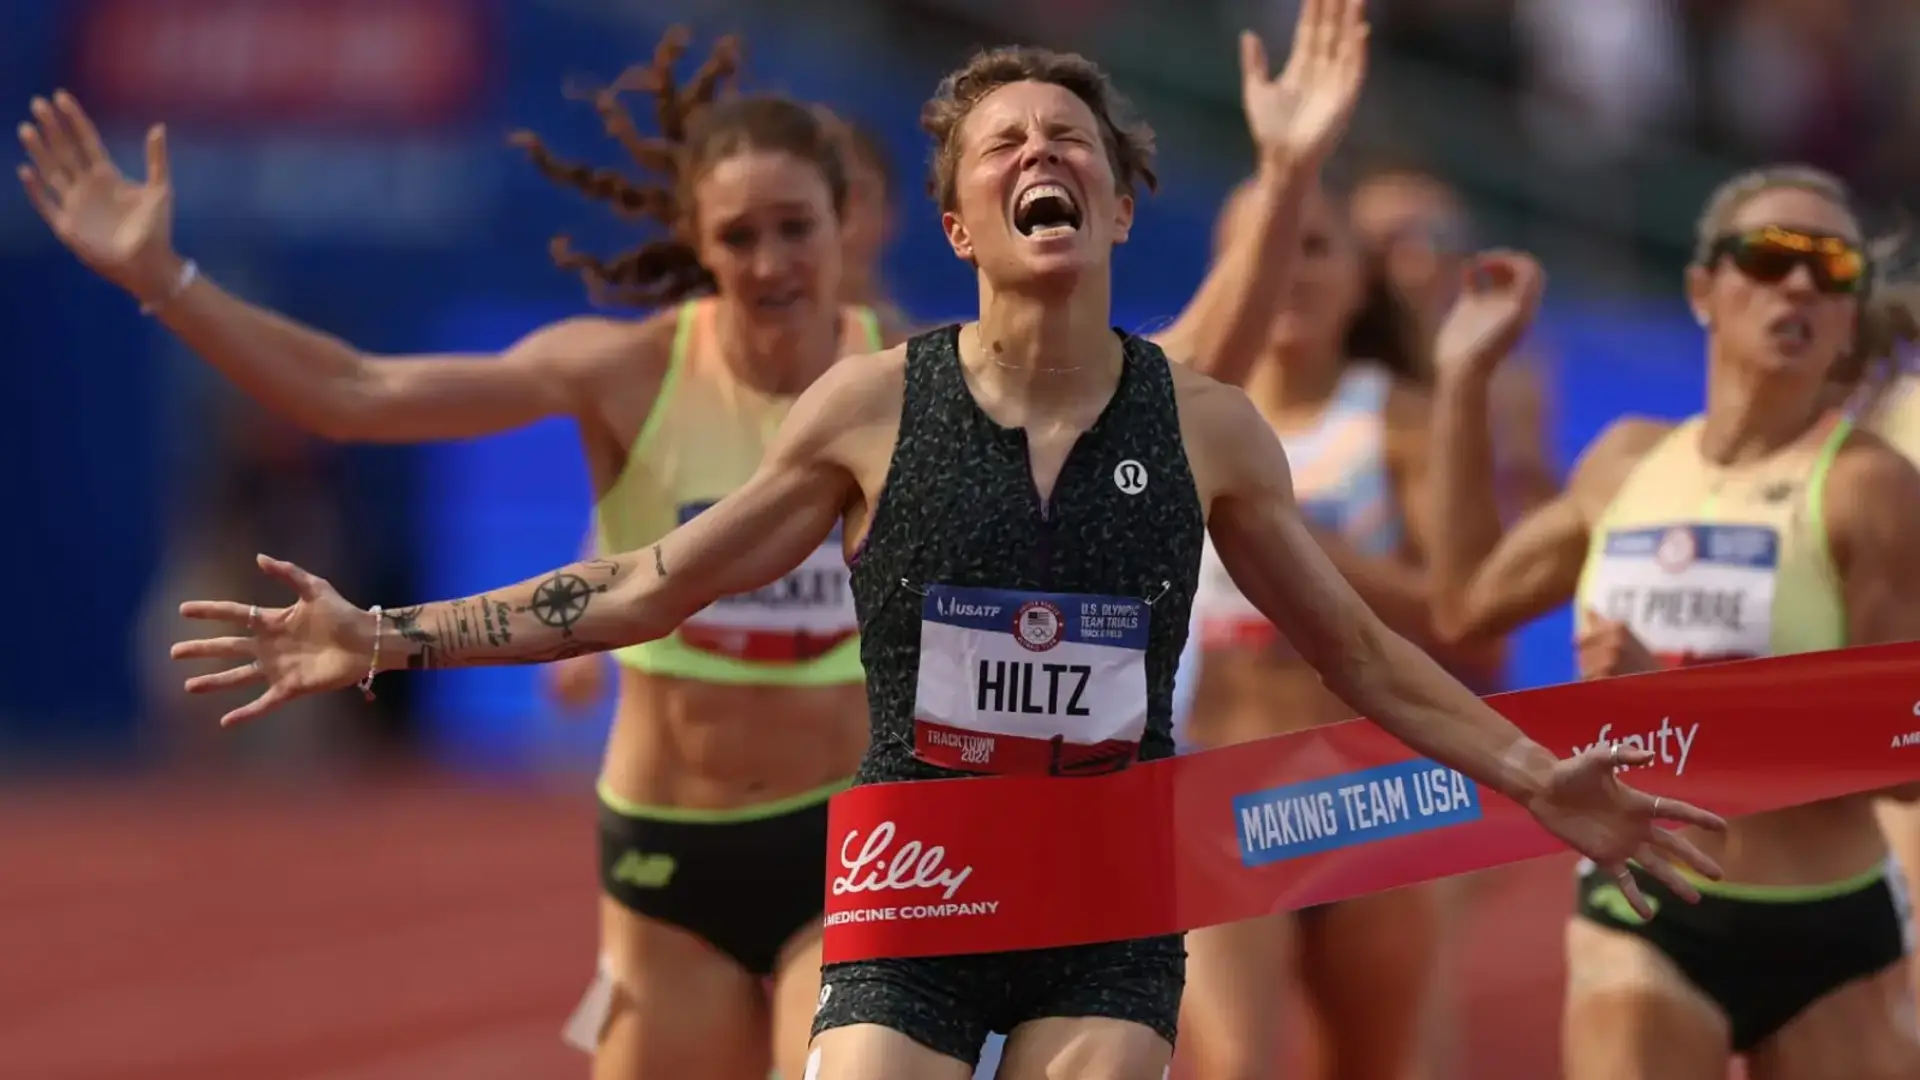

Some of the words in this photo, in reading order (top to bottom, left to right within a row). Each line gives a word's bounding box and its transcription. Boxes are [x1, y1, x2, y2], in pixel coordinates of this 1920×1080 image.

[956, 604, 1001, 617] USATF
[1081, 616, 1104, 627] TEAM
[1106, 617, 1138, 629] TRIALS
[977, 660, 1091, 716] HILTZ
[960, 748, 990, 764] 2024
[1241, 792, 1338, 852] MAKING
[1338, 775, 1410, 831] TEAM
[1413, 768, 1471, 816] USA
[832, 820, 973, 900] Lilly
[900, 901, 999, 919] COMPANY
